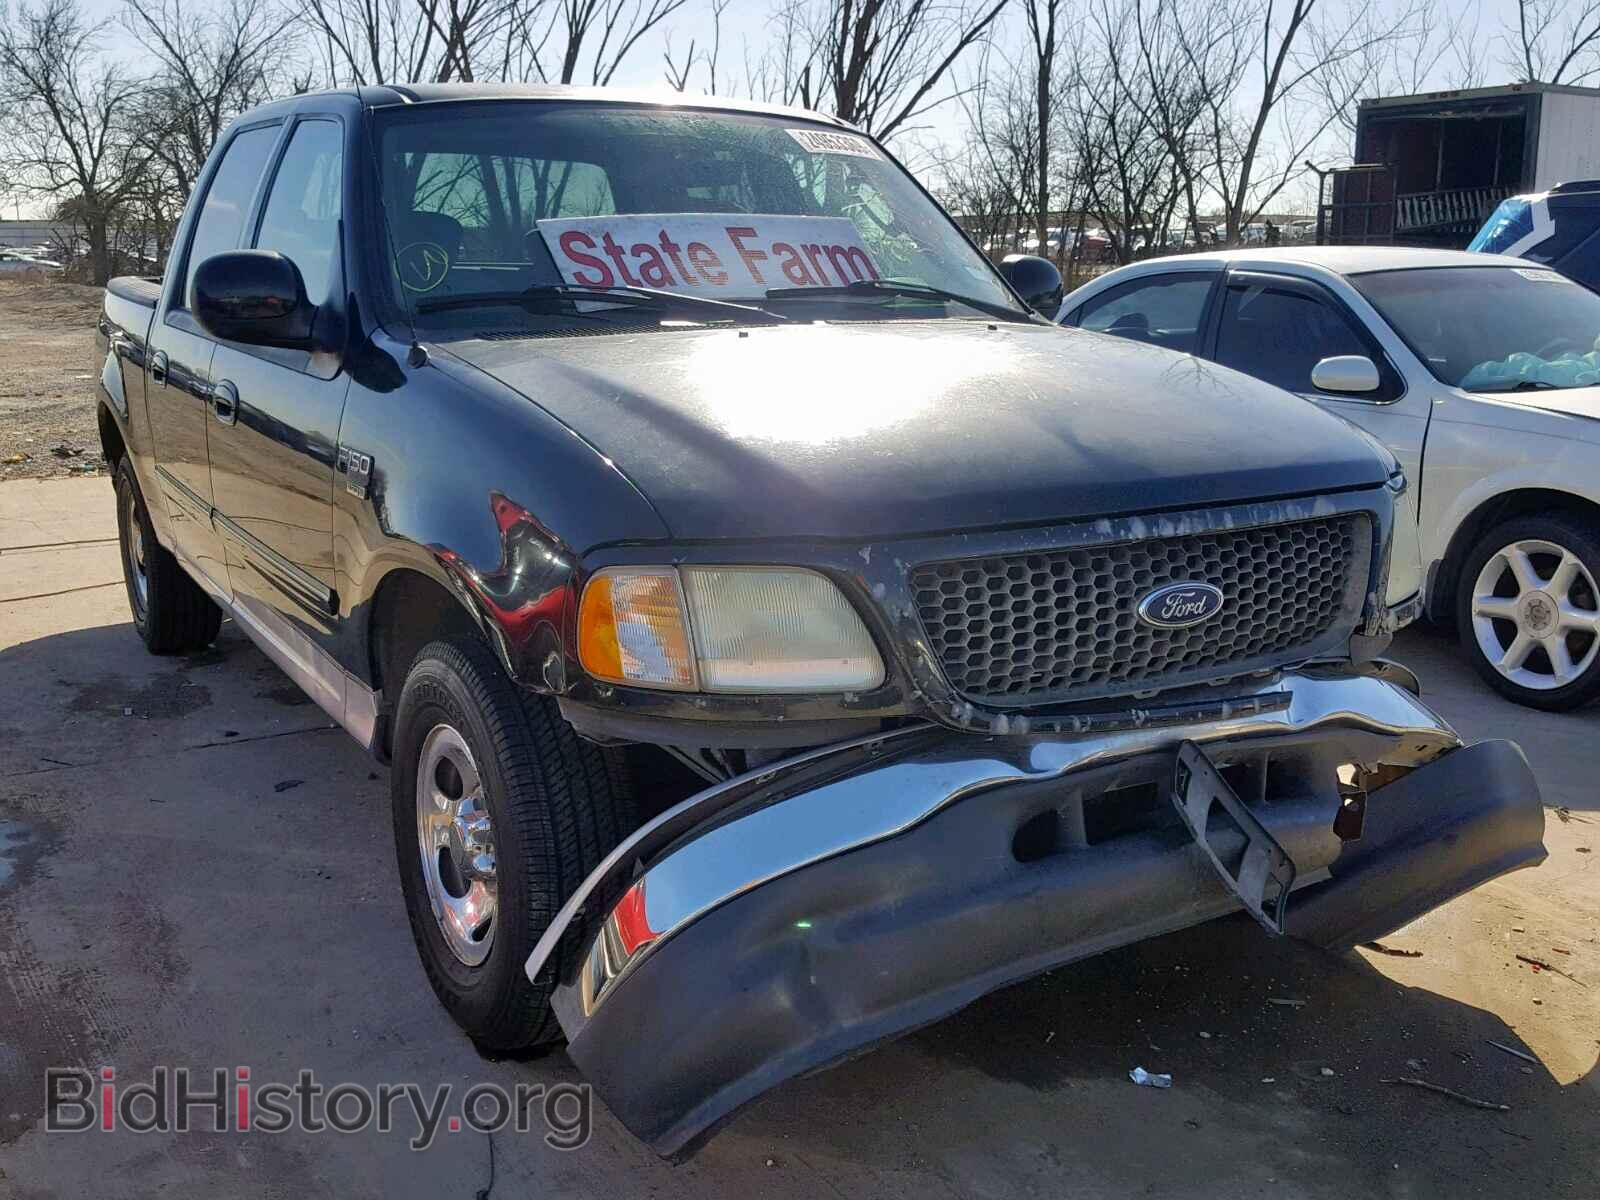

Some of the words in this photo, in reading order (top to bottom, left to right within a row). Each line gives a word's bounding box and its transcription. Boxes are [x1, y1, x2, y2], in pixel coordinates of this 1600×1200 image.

[559, 229, 728, 287] State
[725, 227, 881, 286] Farm
[1161, 592, 1207, 619] Ford
